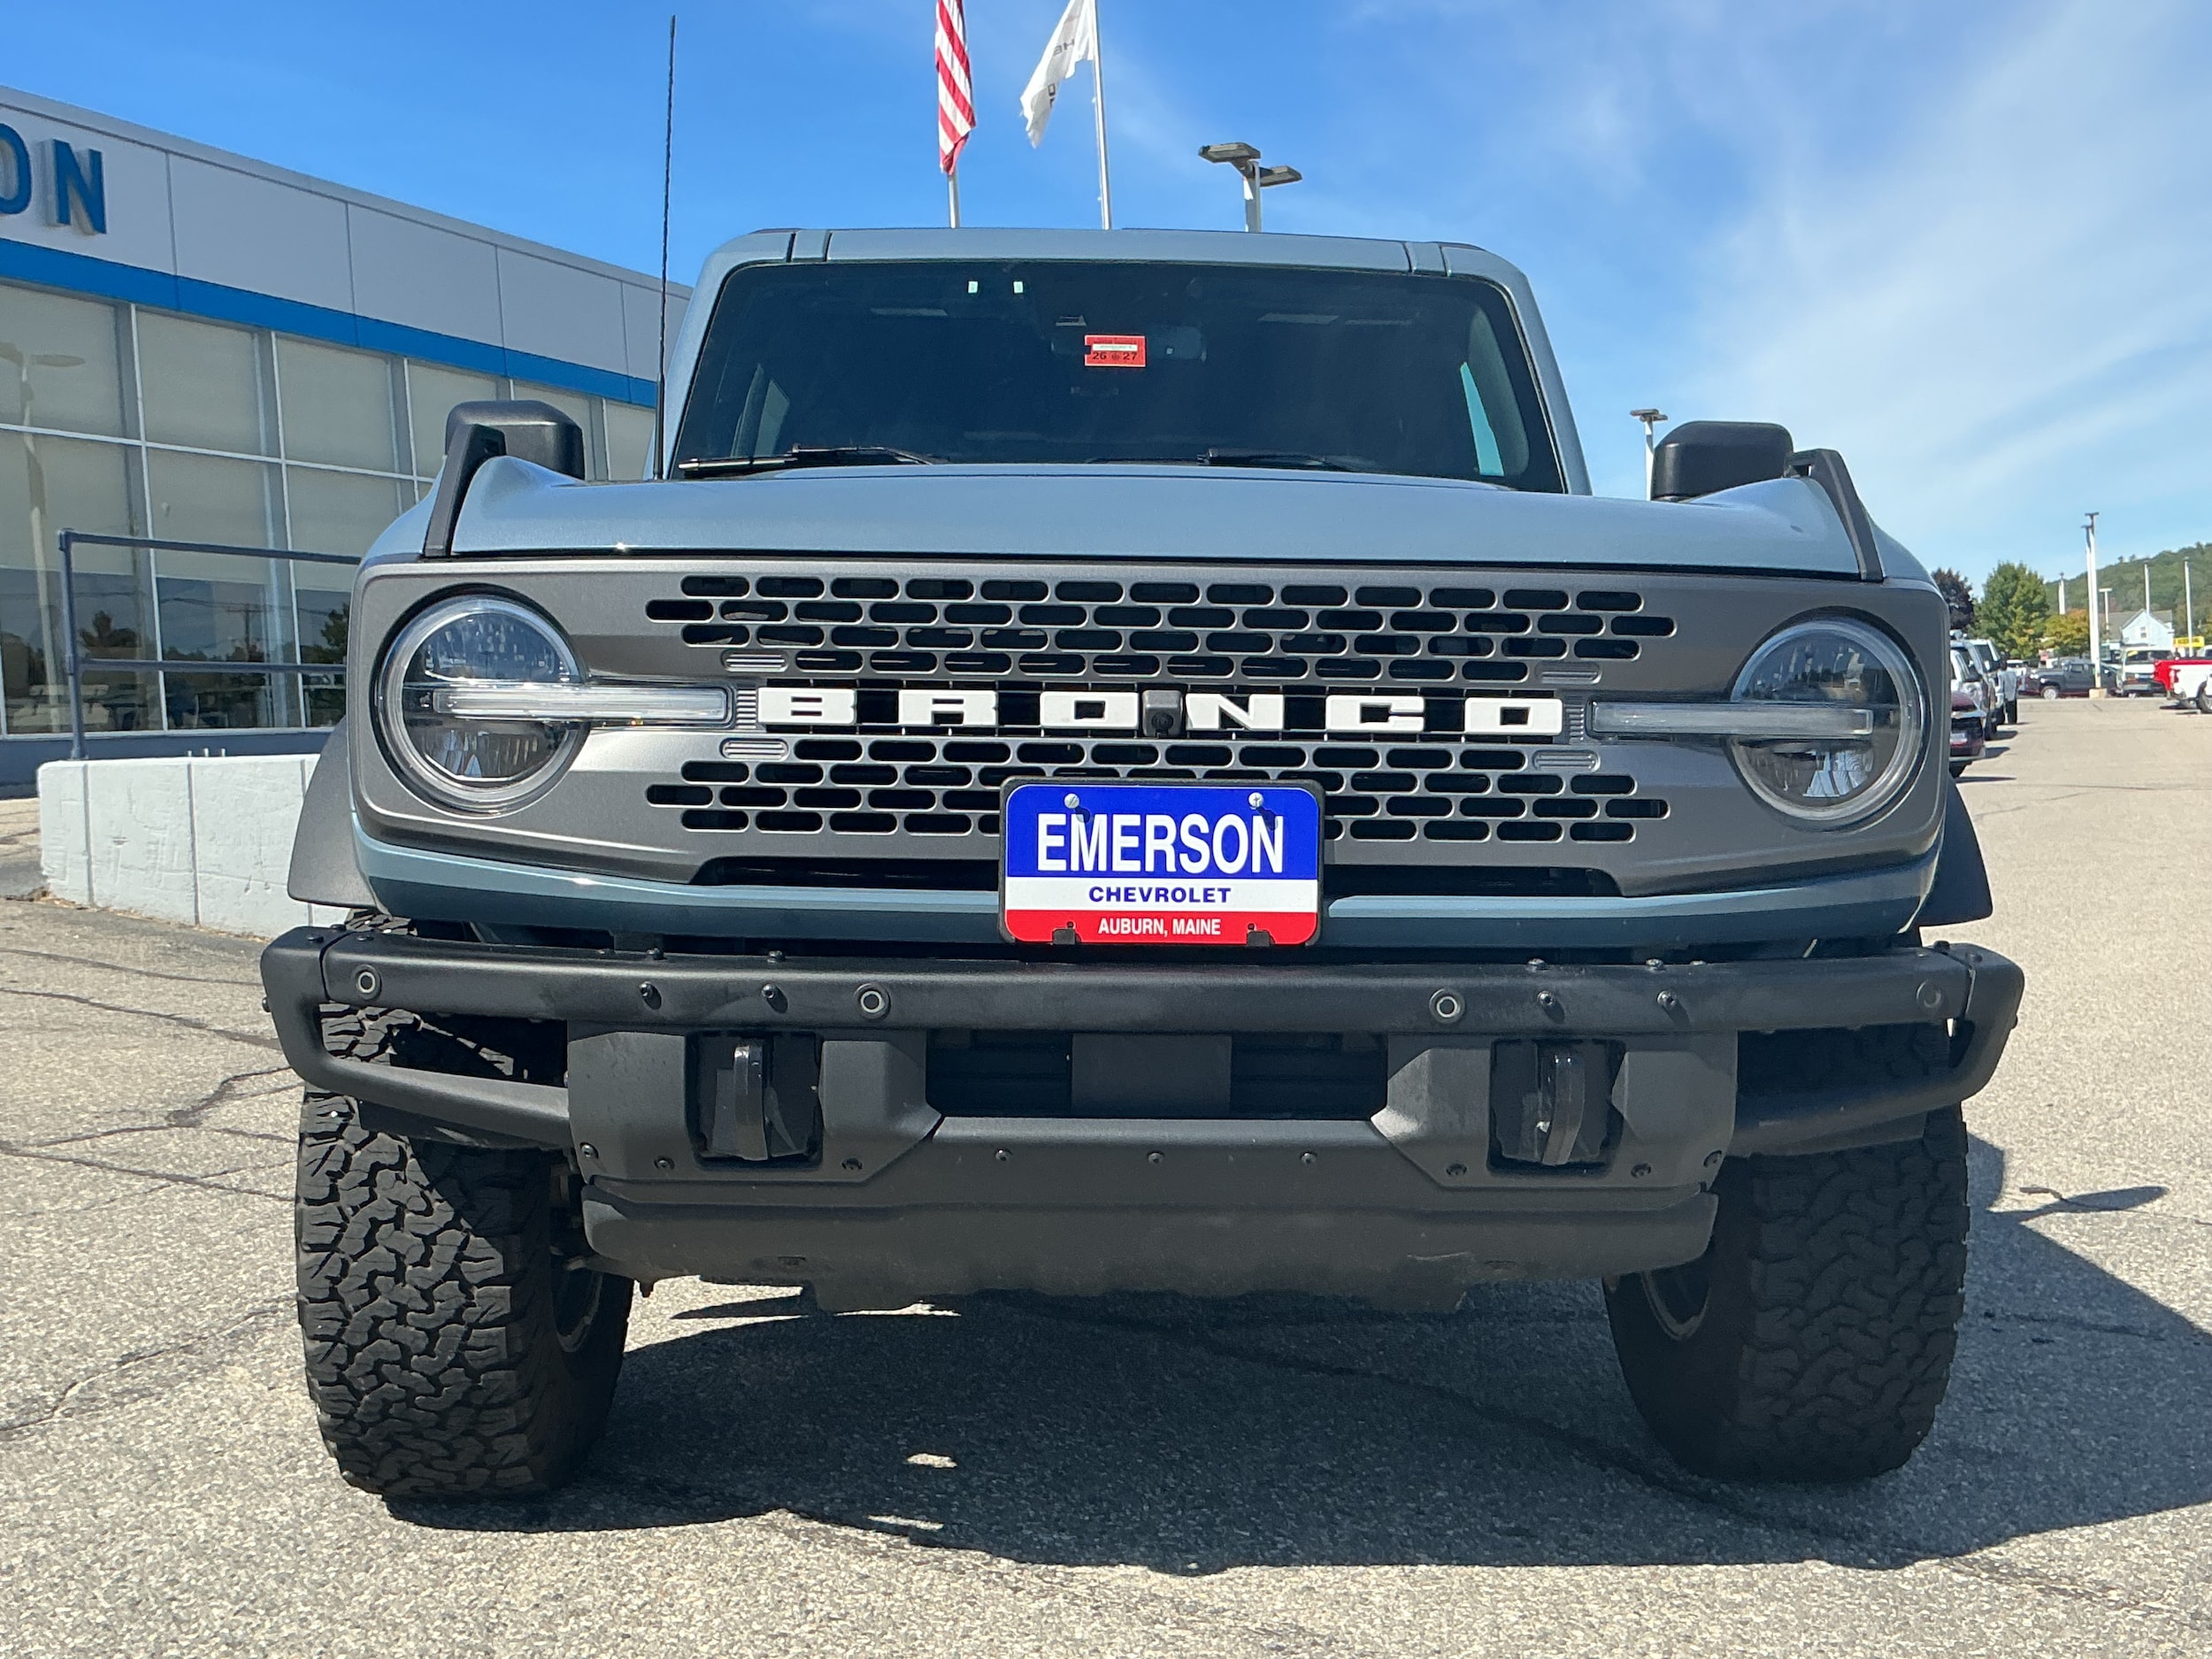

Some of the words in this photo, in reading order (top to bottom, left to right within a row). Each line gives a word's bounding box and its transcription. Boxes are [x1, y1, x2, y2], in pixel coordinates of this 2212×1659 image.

[1092, 350, 1107, 360] 26
[1123, 350, 1138, 361] 27
[757, 687, 1563, 736] BRONCO
[1037, 812, 1284, 874] EMERSON
[1088, 886, 1232, 903] CHEVROLET
[1098, 918, 1169, 938] AUBURN,
[1172, 918, 1221, 935] MAINE
